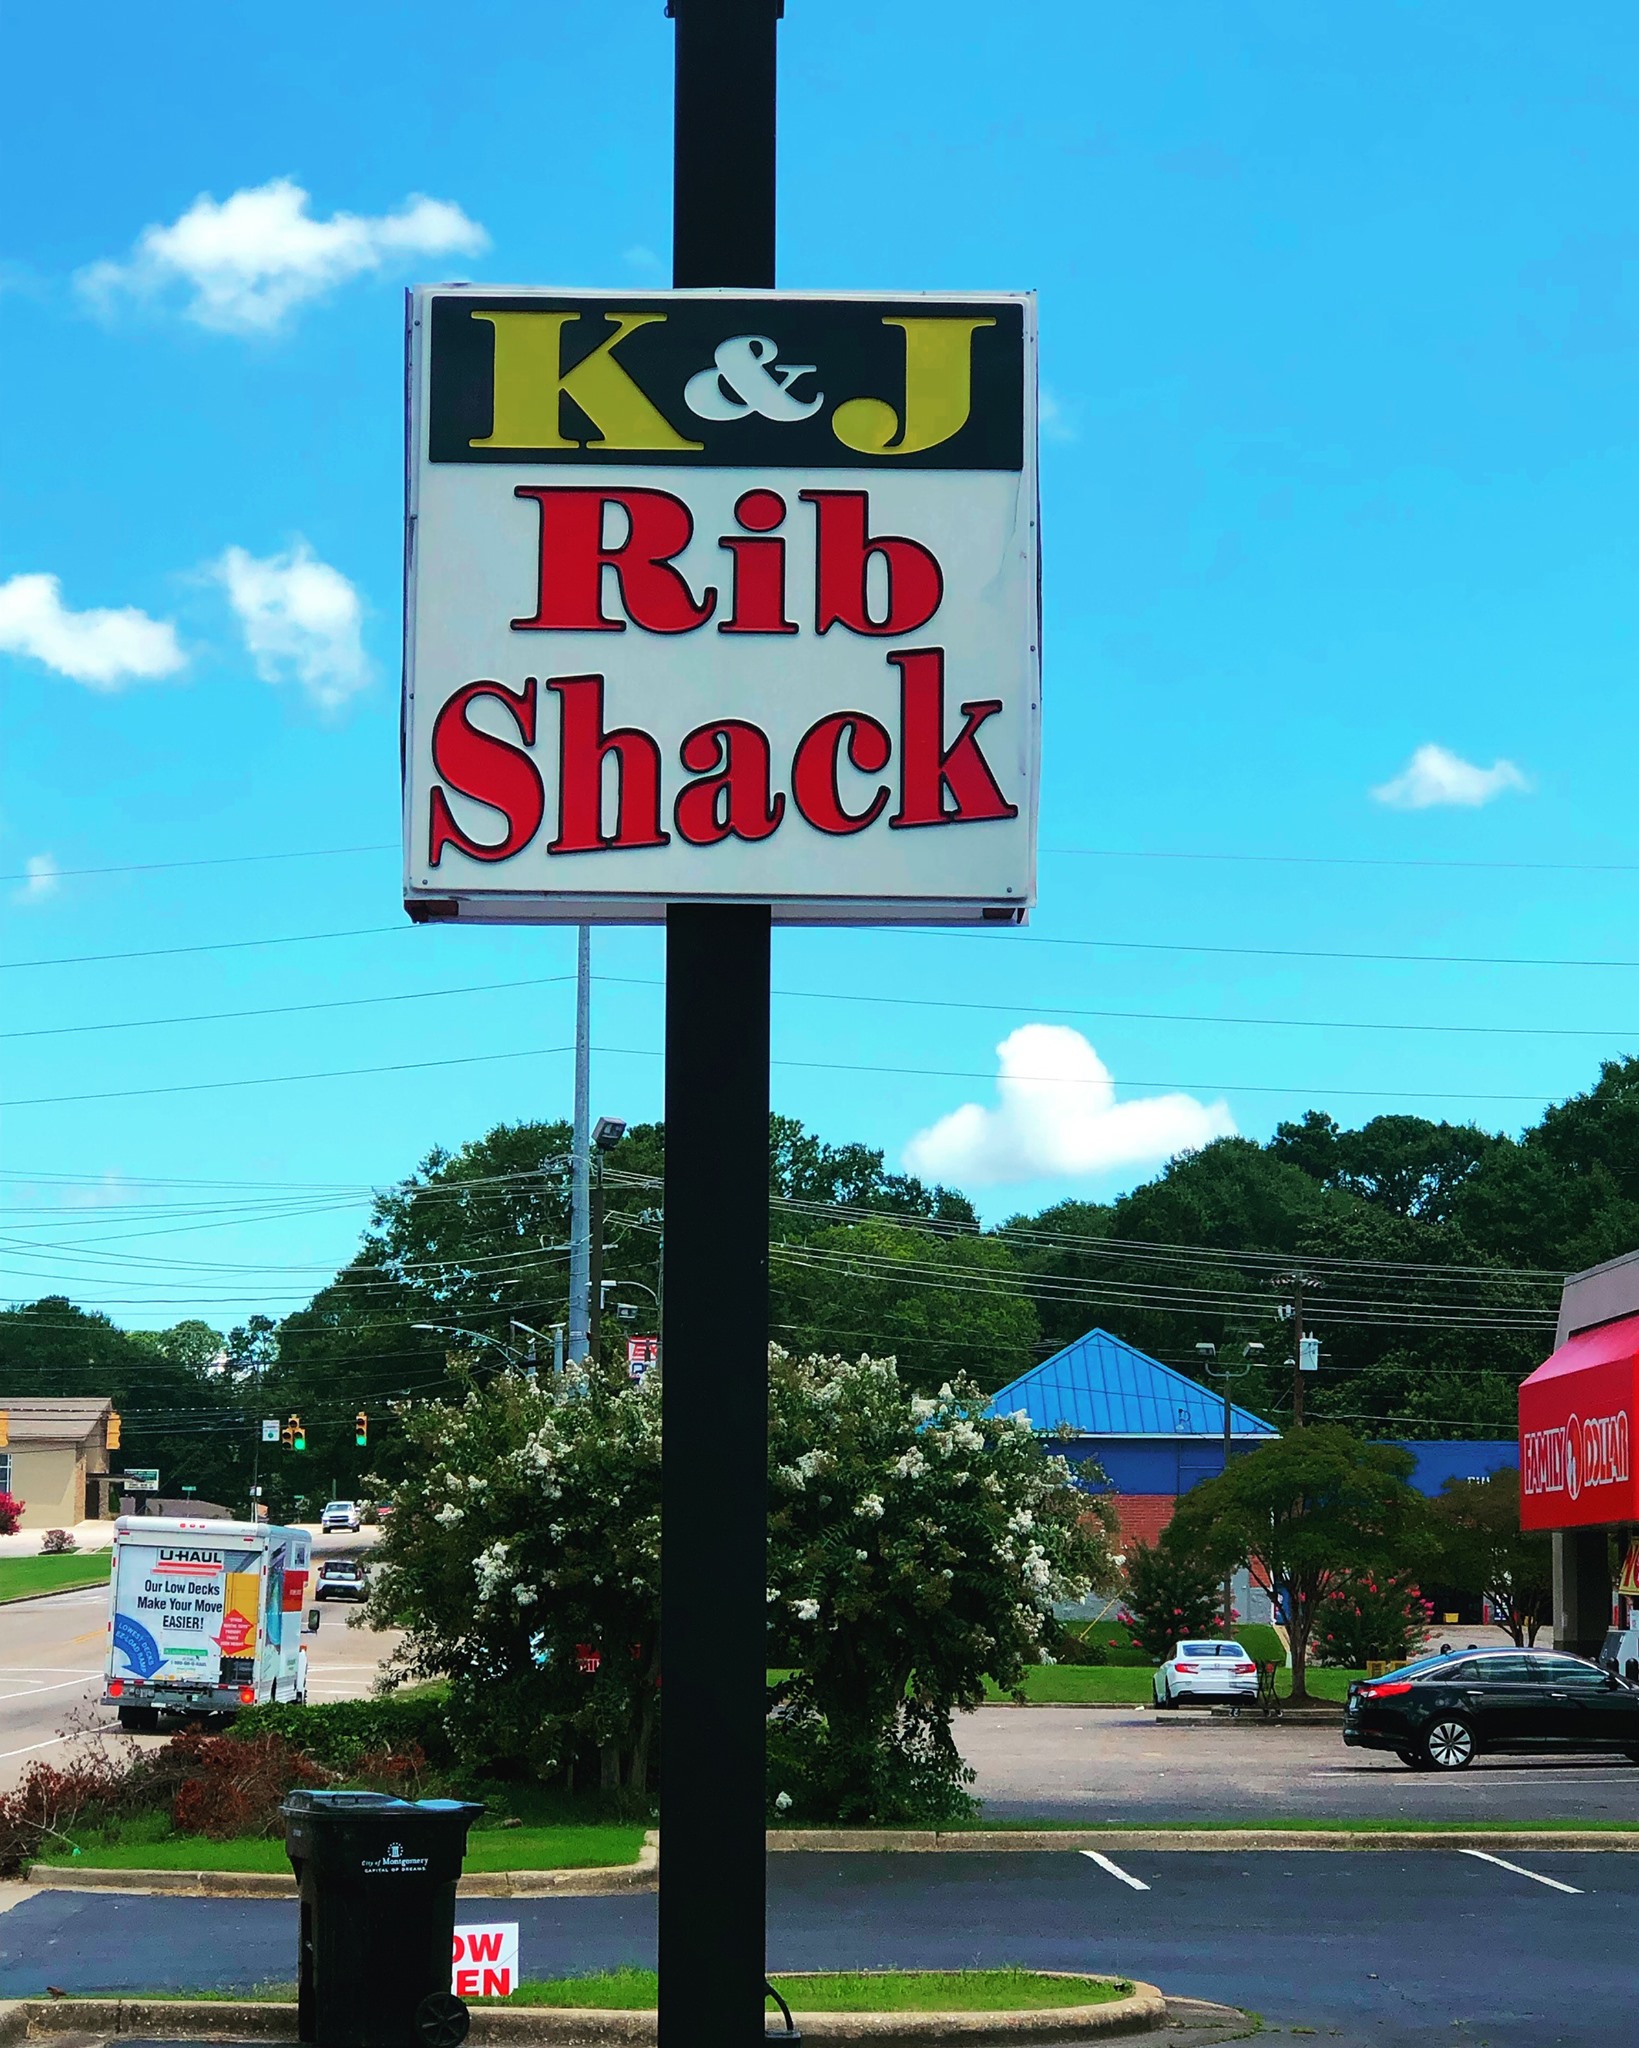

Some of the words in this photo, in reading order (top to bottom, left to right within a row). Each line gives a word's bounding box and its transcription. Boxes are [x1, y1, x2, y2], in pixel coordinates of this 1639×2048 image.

[510, 484, 944, 637] Rib
[428, 646, 1019, 868] Shack
[1524, 1426, 1566, 1495] FAMILY
[1583, 1410, 1629, 1488] DOLLAR
[160, 1549, 222, 1563] U-HAUL
[144, 1579, 162, 1592] Our
[164, 1580, 186, 1594] Low
[188, 1581, 220, 1596] Decks
[137, 1596, 167, 1610] Make
[169, 1598, 192, 1611] Your
[194, 1599, 223, 1613] Move
[162, 1615, 204, 1630] EASIER!
[115, 1631, 141, 1652] EZ-LOAD
[118, 1622, 144, 1642] LOWEST
[141, 1642, 155, 1666] DECKS
[374, 1859, 382, 1867] of
[382, 1857, 429, 1867] Montgomery
[453, 1933, 504, 1963] OW
[456, 1968, 510, 1997] EN
